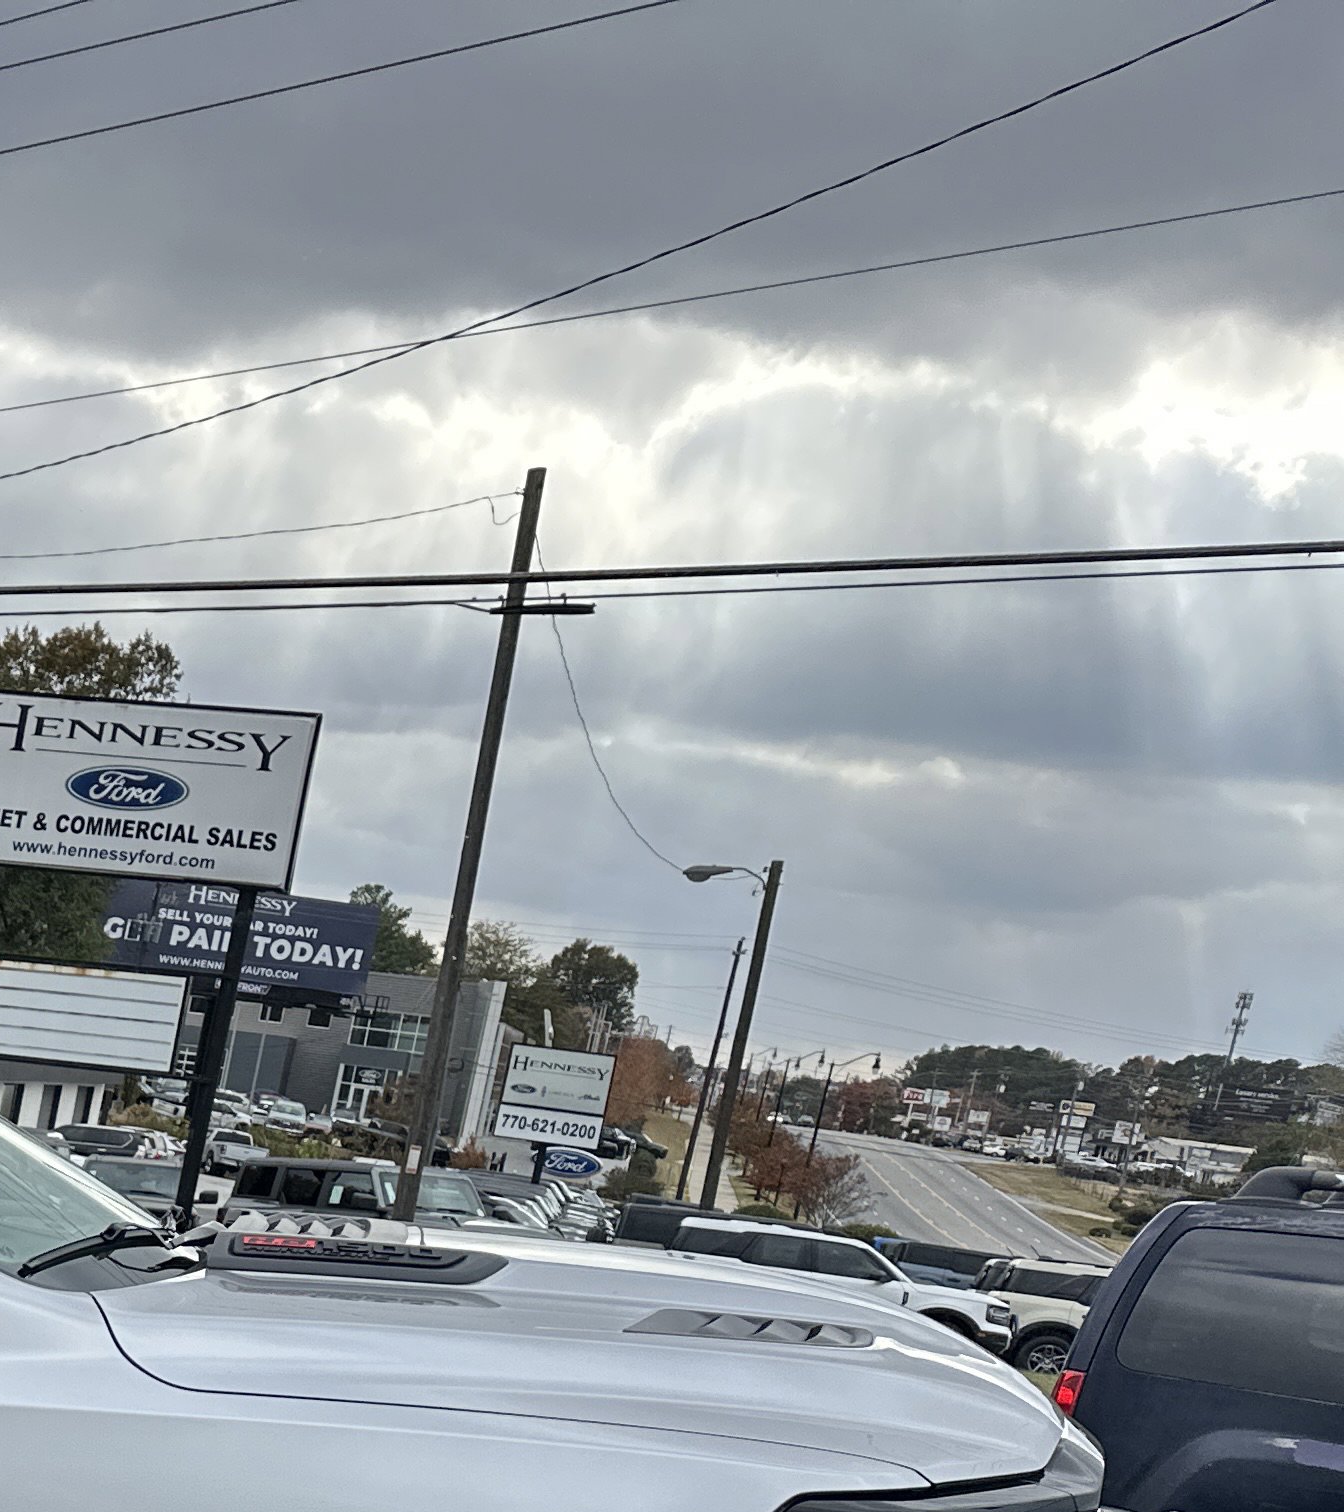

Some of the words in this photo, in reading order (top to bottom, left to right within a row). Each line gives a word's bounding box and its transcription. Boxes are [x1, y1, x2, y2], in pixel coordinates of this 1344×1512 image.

[88, 769, 167, 806] Ford
[32, 813, 48, 832] &
[55, 813, 200, 845] COMMERCIAL
[206, 826, 278, 852] SALES
[12, 840, 216, 870] www.hennessyford.com
[158, 907, 191, 922] SELL
[195, 912, 233, 927] YOUR
[268, 922, 319, 939] TODAY!
[159, 954, 299, 981] WWW.HENNYAUTO.COM
[253, 935, 364, 971] TODAY!
[512, 1055, 610, 1081] HENNESSY
[501, 1113, 597, 1140] 770-621-0200
[544, 1151, 588, 1173] Ford
